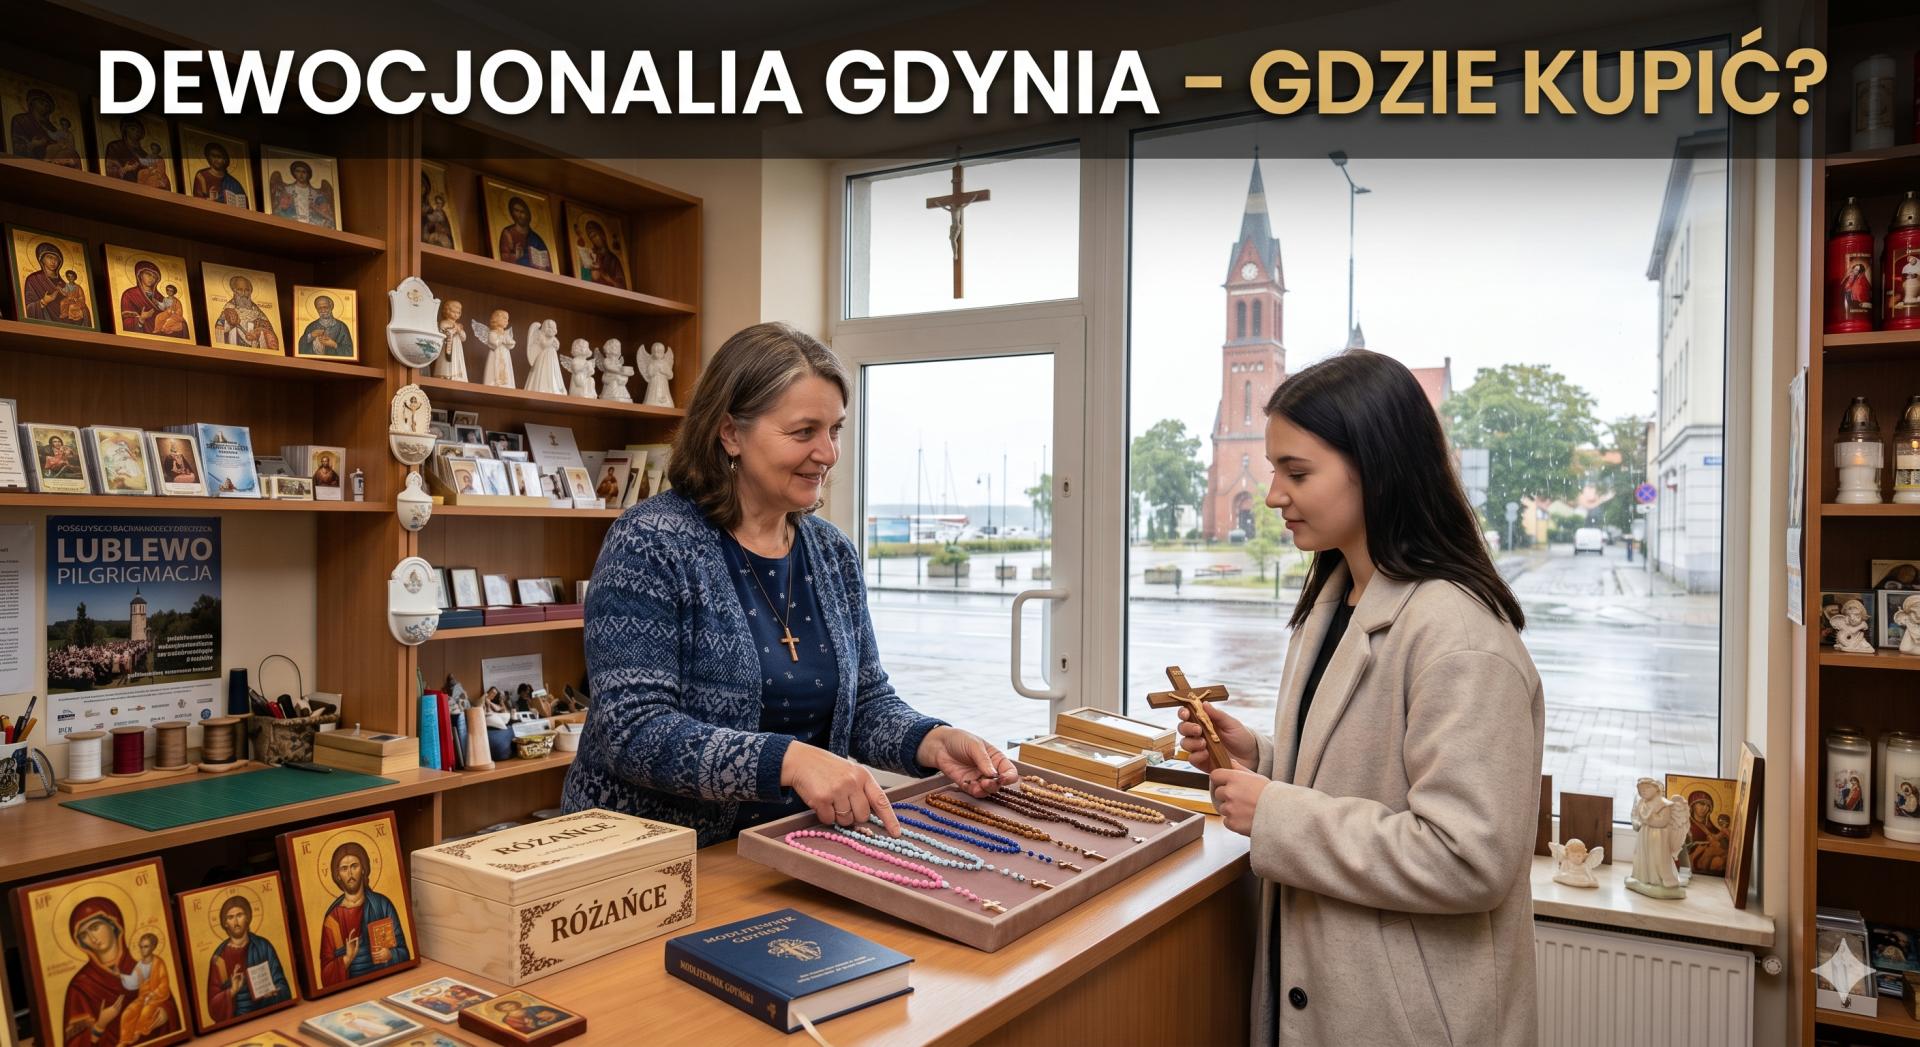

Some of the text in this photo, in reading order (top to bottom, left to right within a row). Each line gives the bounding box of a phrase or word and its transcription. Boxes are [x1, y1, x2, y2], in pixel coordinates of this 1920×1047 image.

[57, 538, 213, 563] LUBLEWO
[57, 565, 213, 585] PILGRIGMACJA
[551, 884, 667, 943] RÓŻAŃCE
